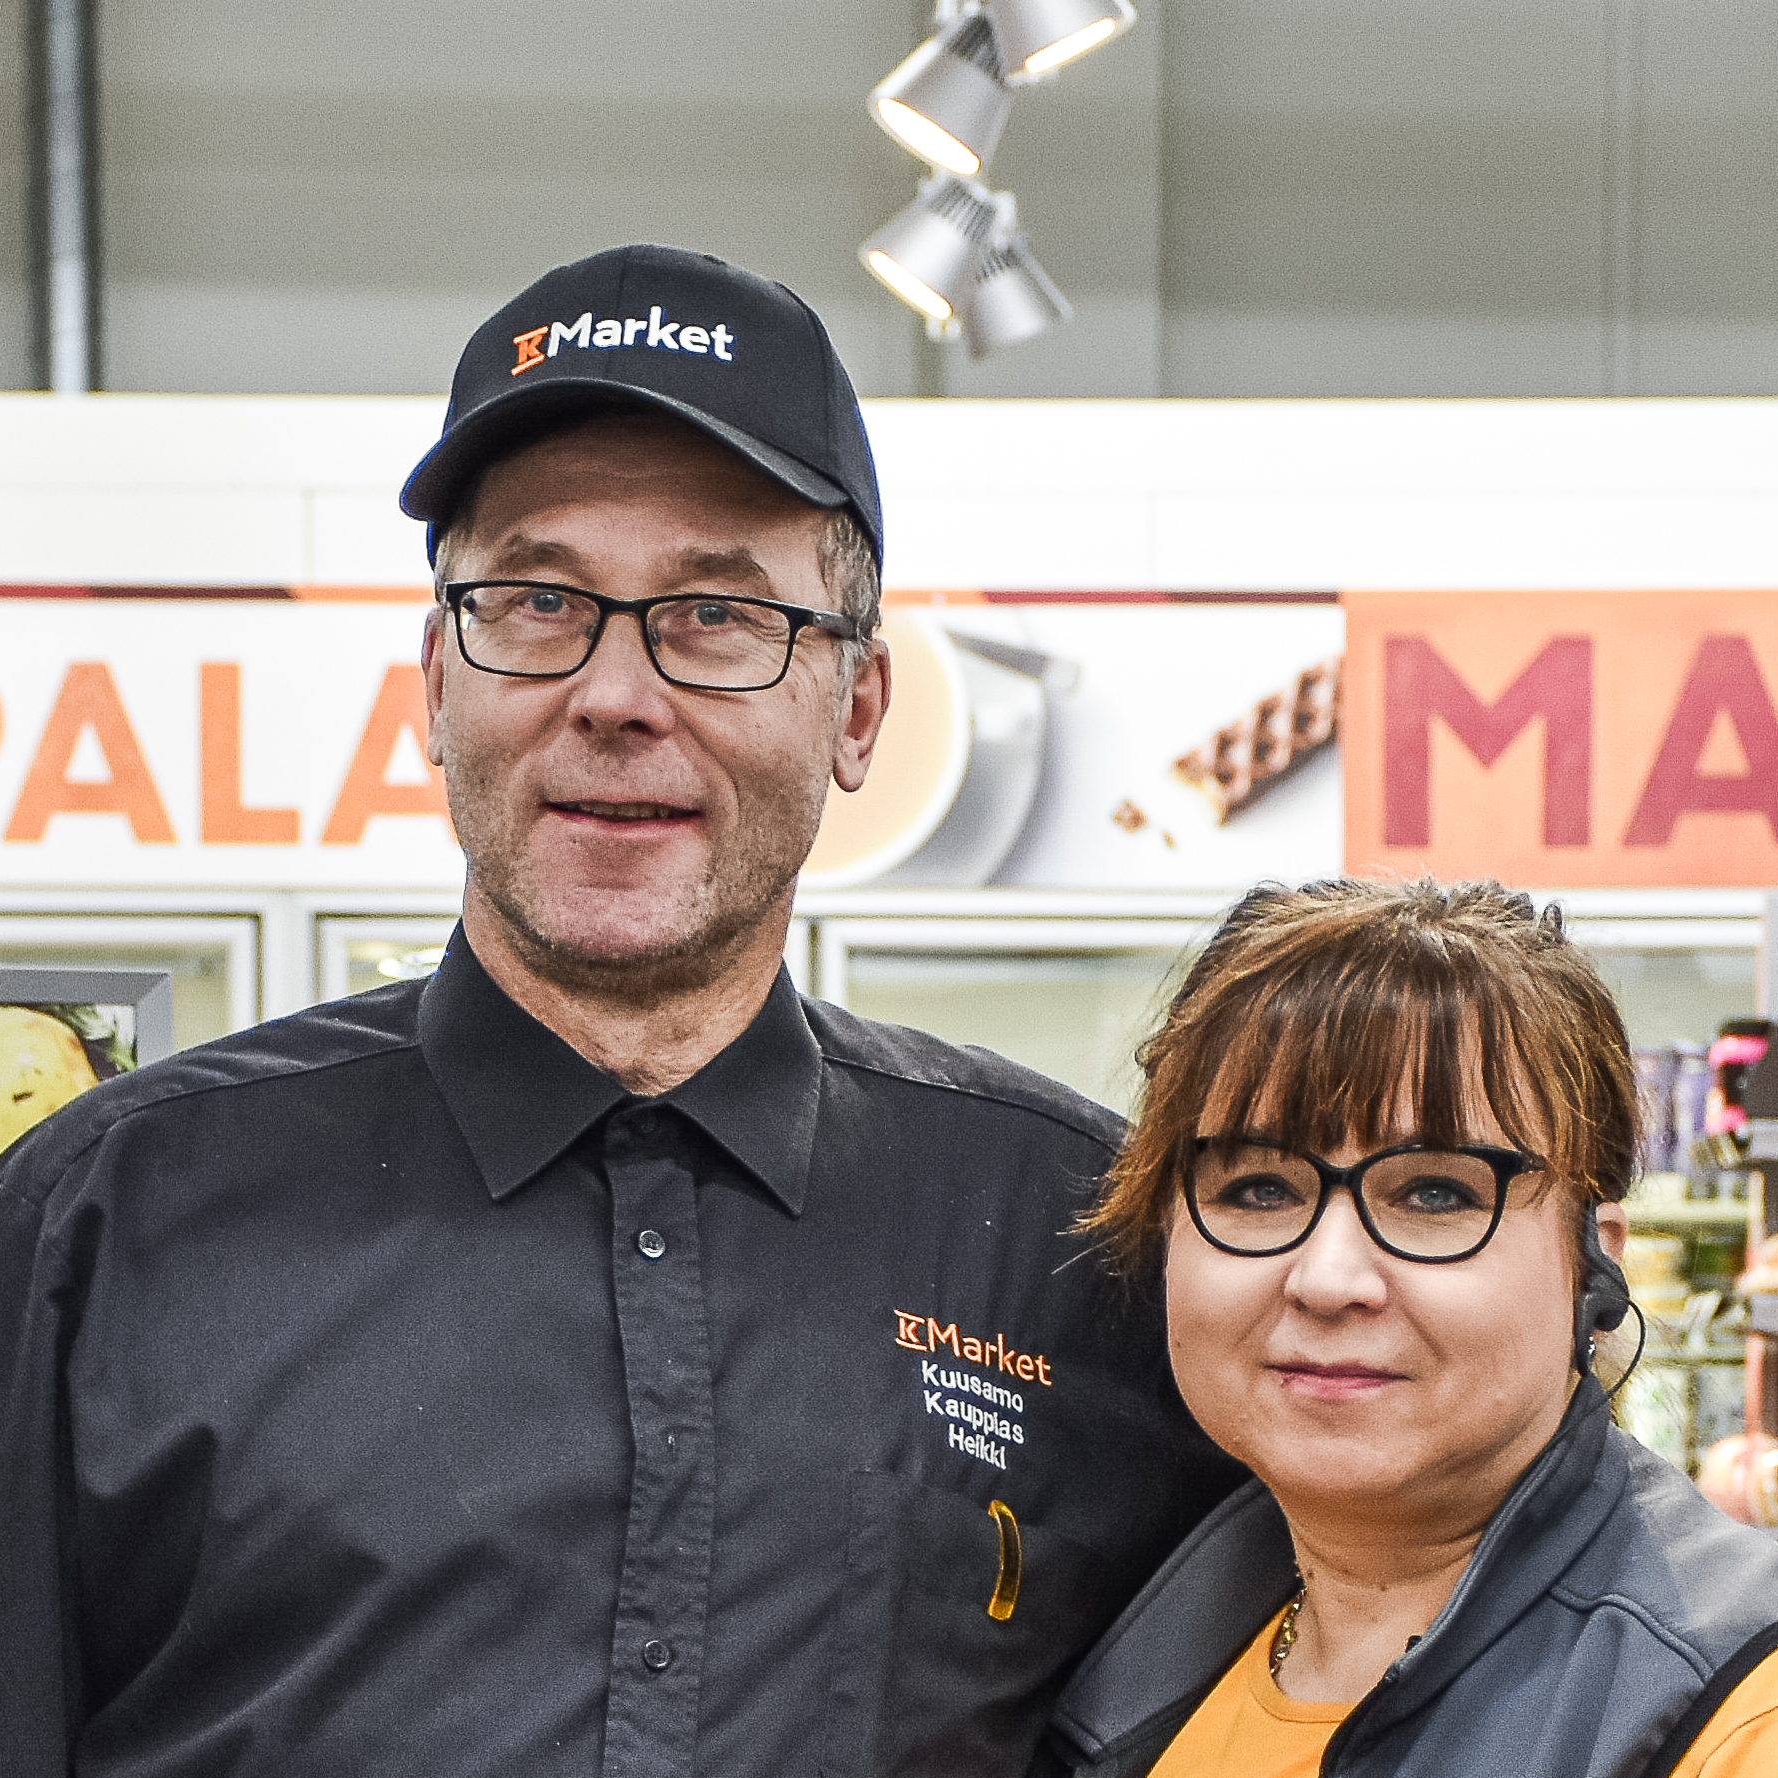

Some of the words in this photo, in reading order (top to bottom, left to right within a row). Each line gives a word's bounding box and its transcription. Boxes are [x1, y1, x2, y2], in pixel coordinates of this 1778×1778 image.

[546, 305, 736, 363] Market
[926, 1316, 1053, 1388] Market
[921, 1359, 1025, 1413] Kuusamo
[923, 1389, 1025, 1445] Kauppias
[947, 1422, 1008, 1471] Heikki
